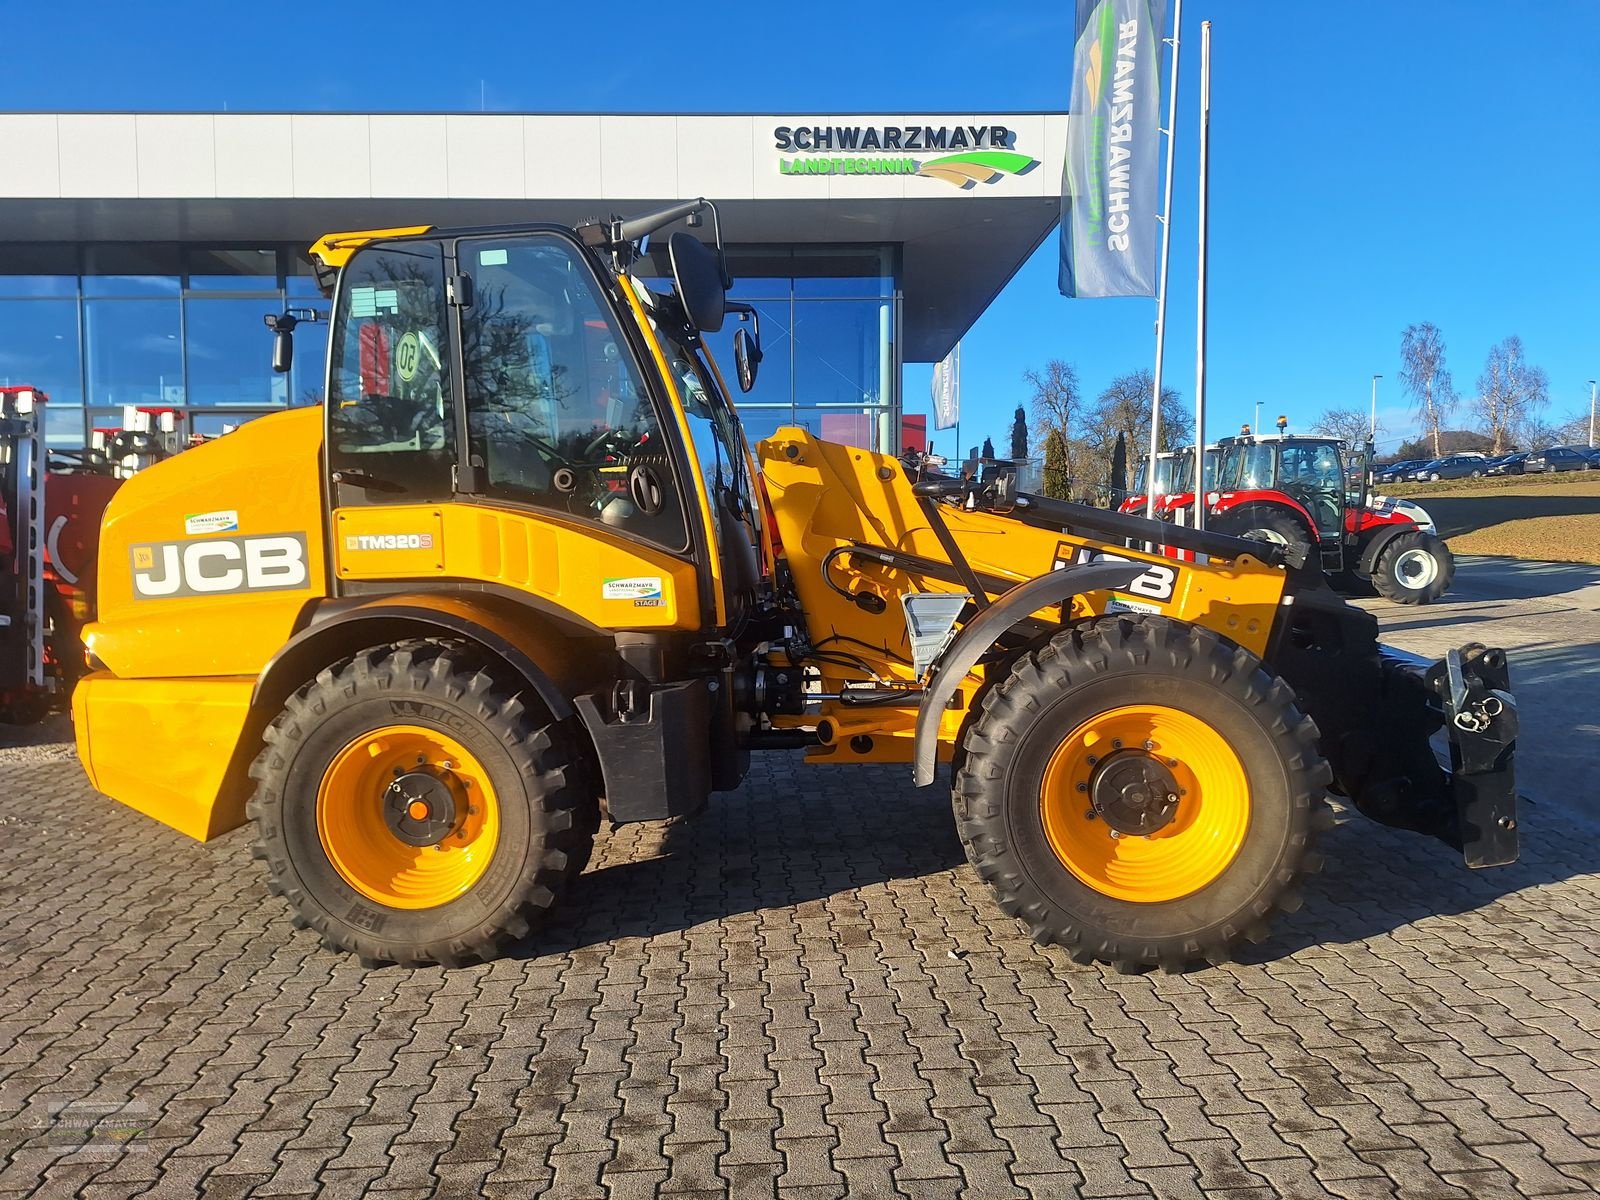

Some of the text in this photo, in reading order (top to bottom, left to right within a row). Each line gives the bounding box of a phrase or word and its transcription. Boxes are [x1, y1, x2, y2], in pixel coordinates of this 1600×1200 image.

[774, 126, 1009, 150] SCHWARZMAYR
[780, 158, 915, 175] LANDTECHNIK
[359, 534, 432, 549] TM320S
[135, 536, 306, 596] JCB
